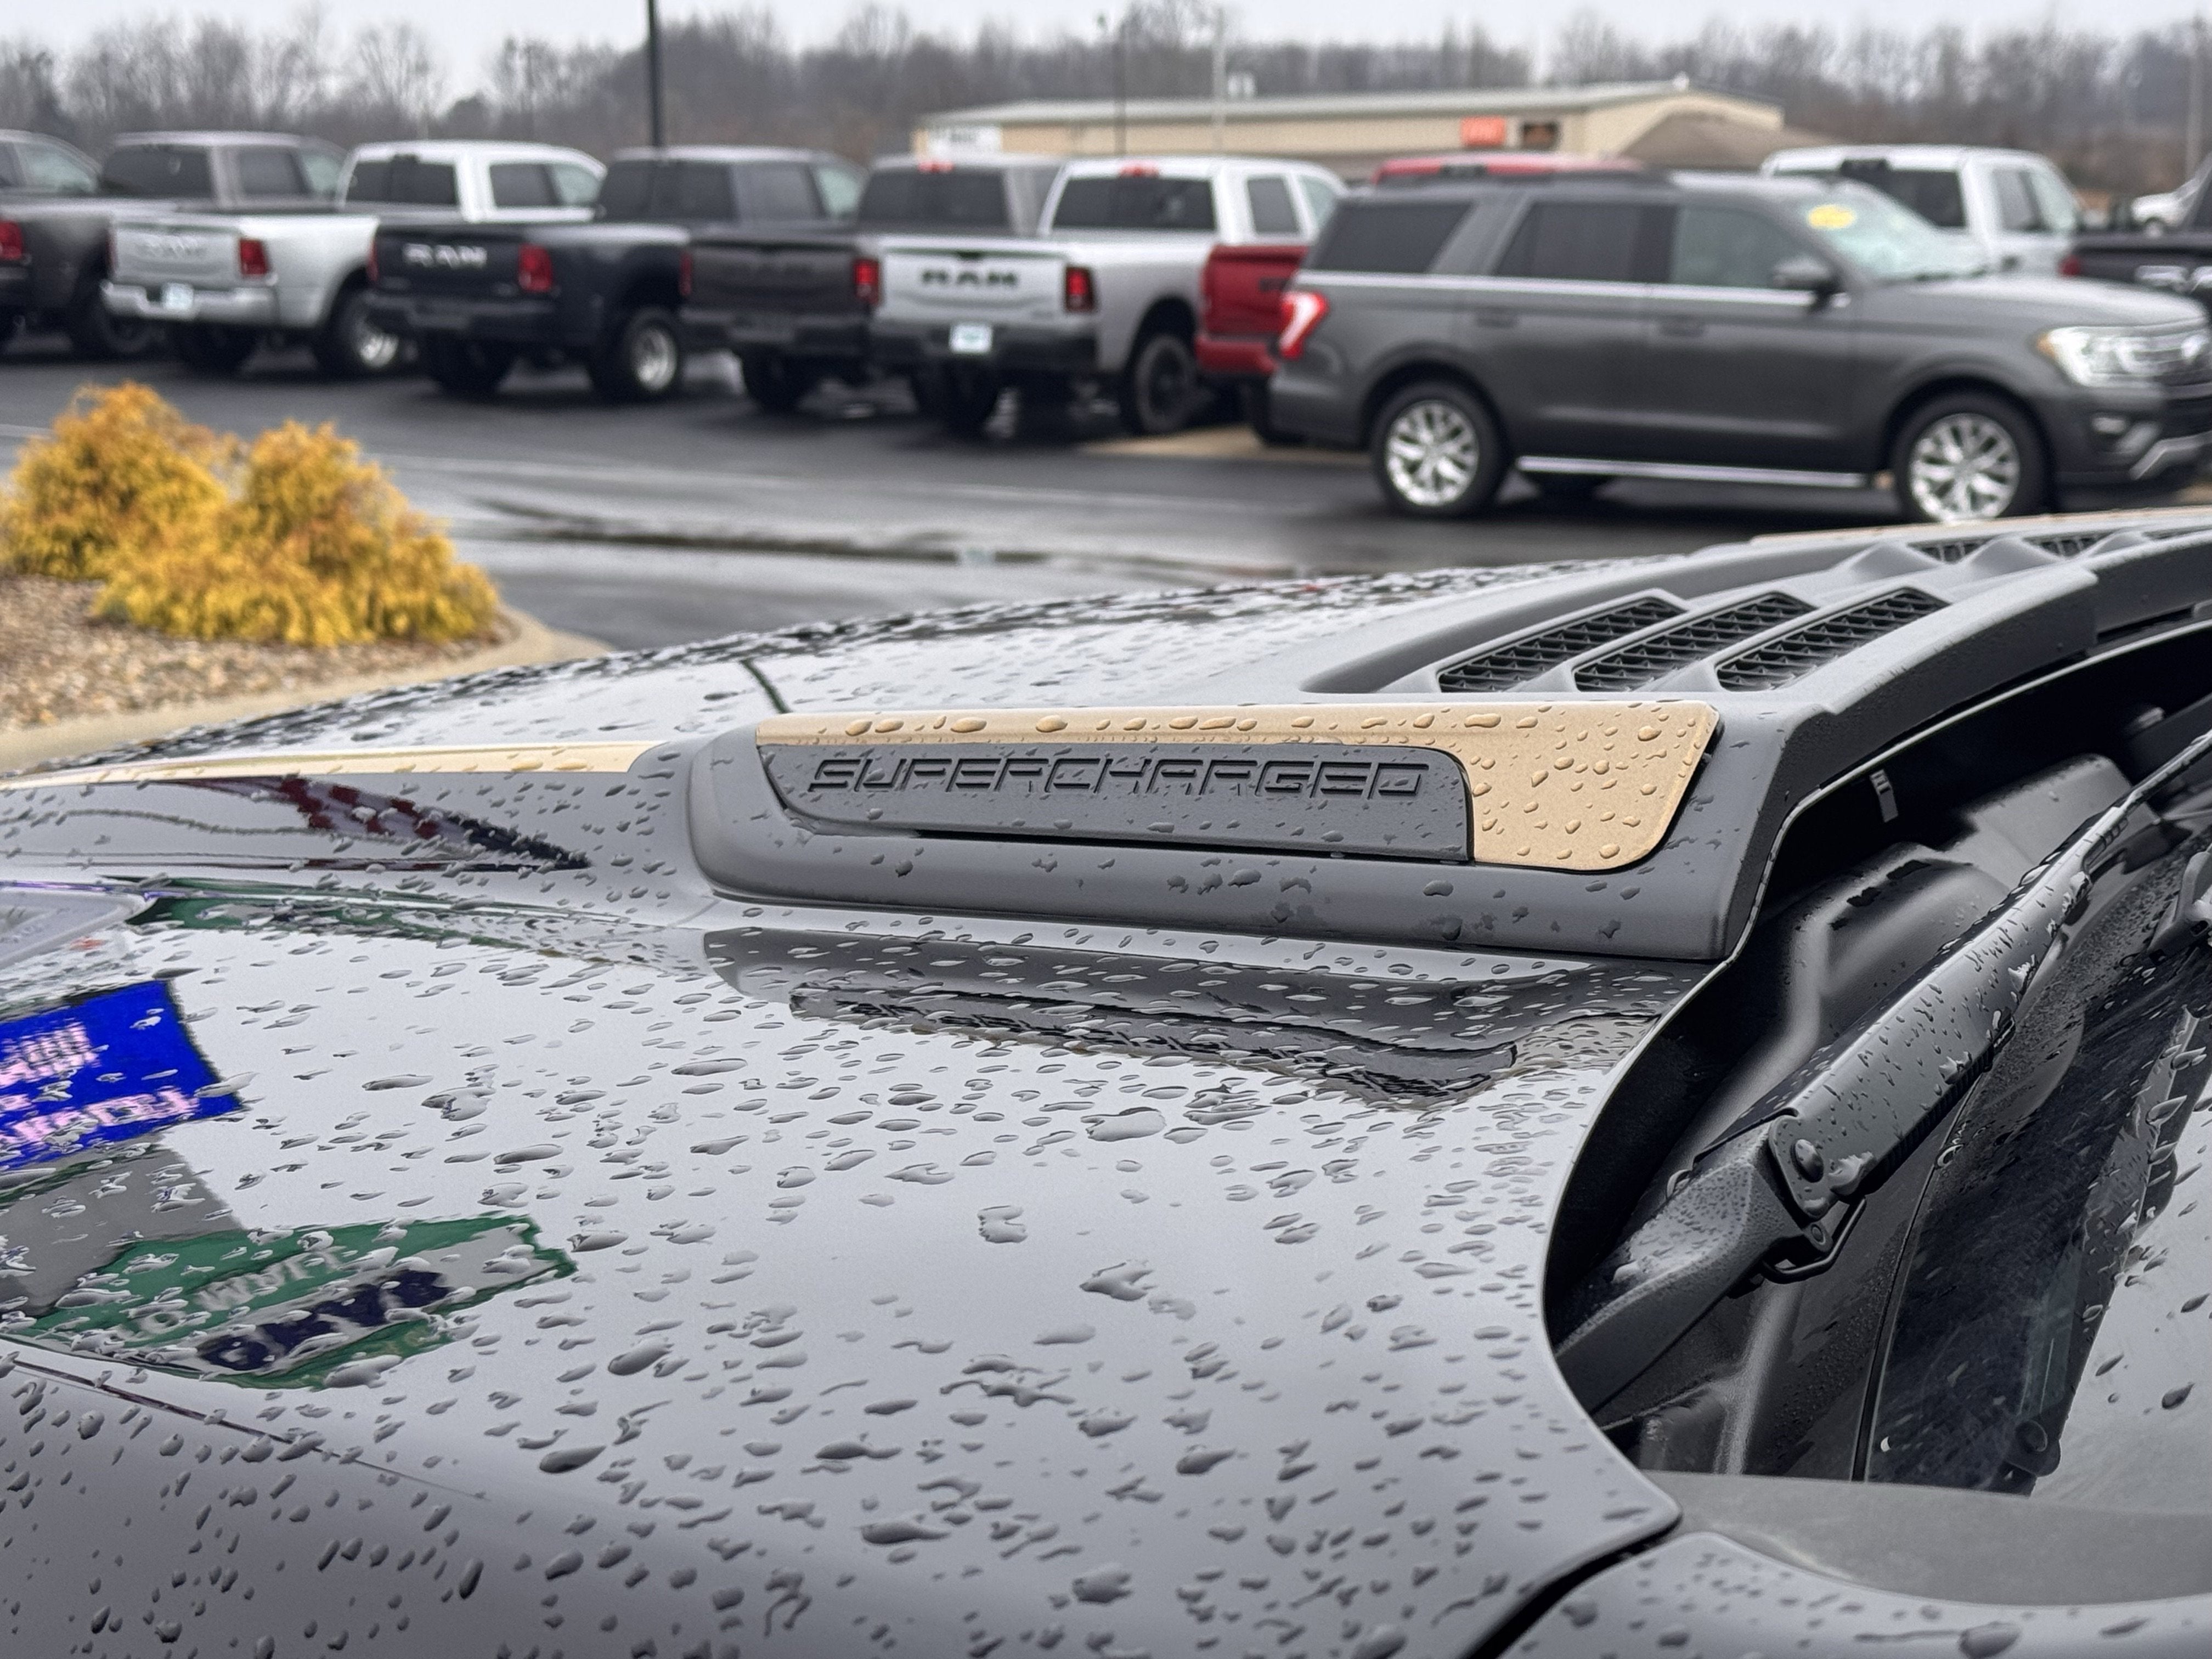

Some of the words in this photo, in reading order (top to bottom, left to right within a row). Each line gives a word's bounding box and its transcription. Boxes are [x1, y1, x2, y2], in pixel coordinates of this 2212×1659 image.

[403, 243, 488, 269] RAM
[922, 269, 1019, 286] RAM
[806, 758, 1430, 800] SUPERCHARGED
